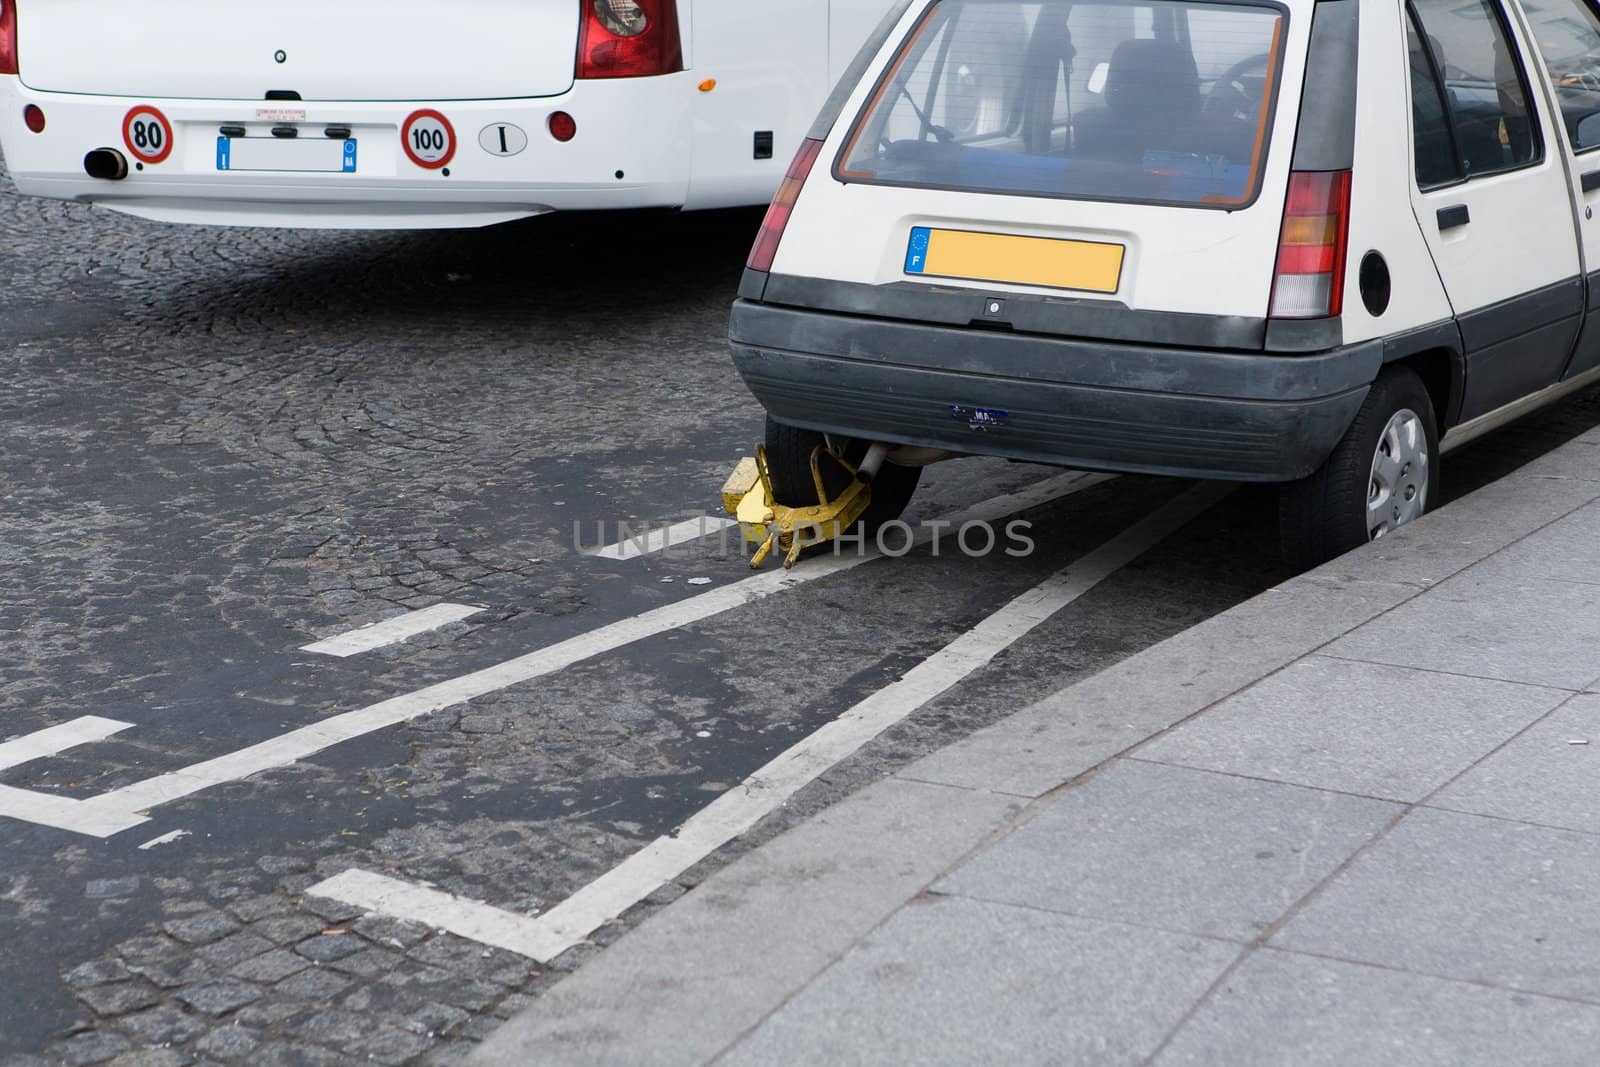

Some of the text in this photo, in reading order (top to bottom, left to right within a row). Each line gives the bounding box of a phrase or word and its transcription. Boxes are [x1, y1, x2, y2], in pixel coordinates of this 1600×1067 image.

[133, 120, 162, 149] 80
[412, 128, 444, 150] 100
[497, 126, 508, 152] I
[912, 255, 921, 266] F
